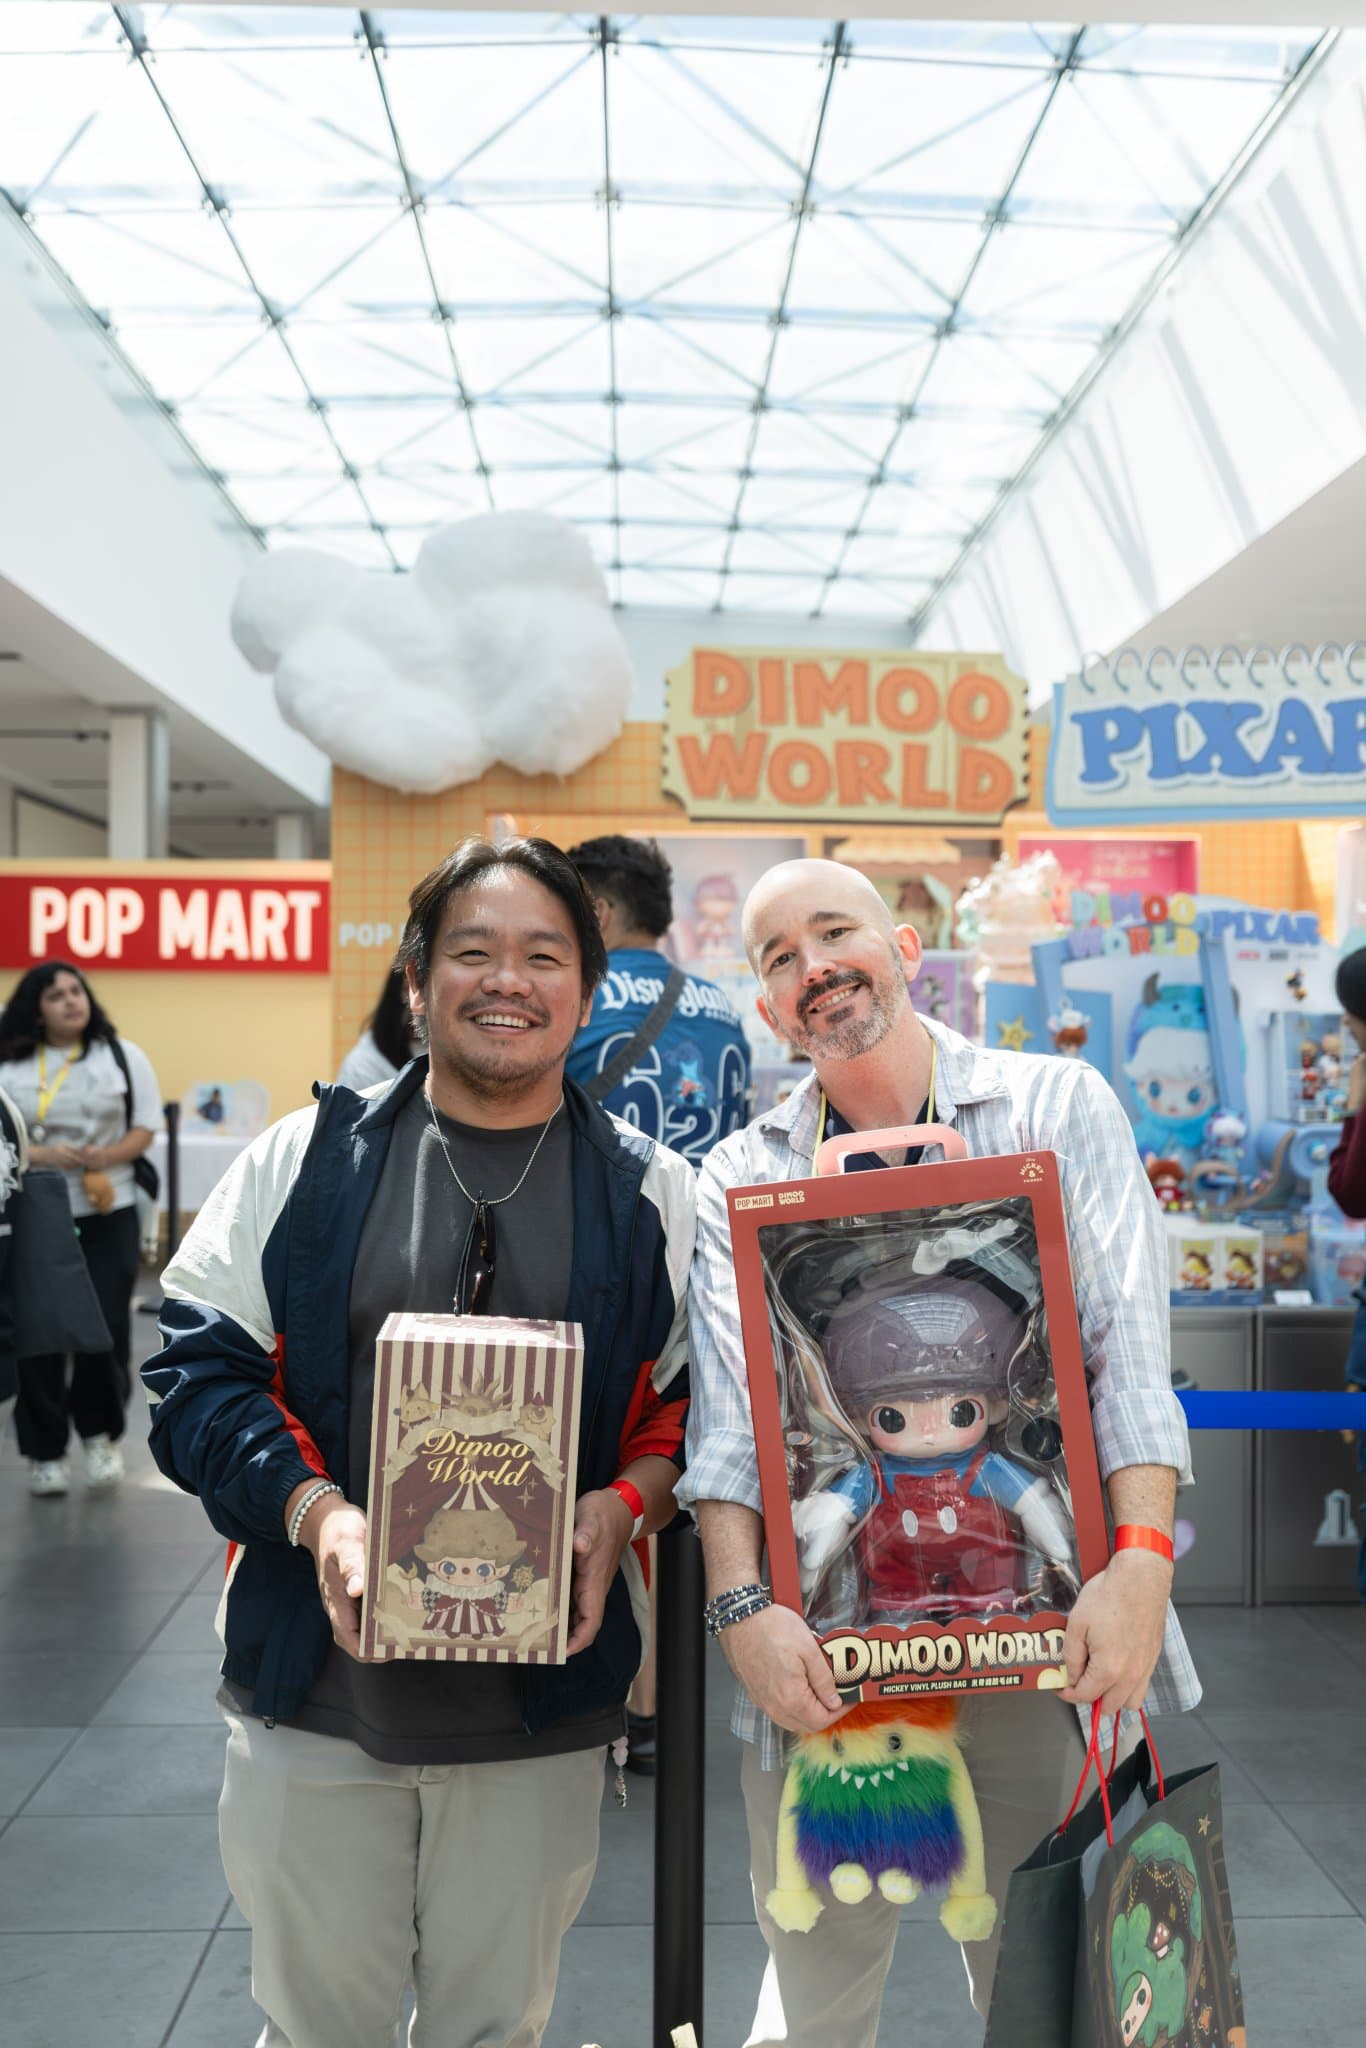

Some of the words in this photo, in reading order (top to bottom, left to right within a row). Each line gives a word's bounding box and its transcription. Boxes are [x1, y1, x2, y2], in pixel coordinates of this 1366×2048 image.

[692, 649, 1012, 741] DIMOO
[676, 731, 1015, 814] WORLD
[29, 886, 145, 959] POP
[157, 888, 321, 961] MART
[1072, 891, 1196, 925] DIMOO
[339, 922, 393, 948] POP
[1068, 927, 1200, 957] WORLD
[1210, 908, 1320, 946] PIXAR
[600, 970, 734, 1018] Disnylan
[737, 1199, 750, 1209] POP
[752, 1196, 771, 1207] MART
[778, 1191, 804, 1200] DIMOO
[779, 1197, 805, 1205] WORLD
[421, 1428, 529, 1457] Dimoo
[427, 1456, 532, 1487] World
[821, 1635, 962, 1683] DIMOO
[966, 1629, 1067, 1669] WORLD
[883, 1683, 909, 1694] MICKEY
[910, 1682, 930, 1692] VINYL
[930, 1680, 952, 1690] PLUSH
[953, 1679, 967, 1688] BAG
